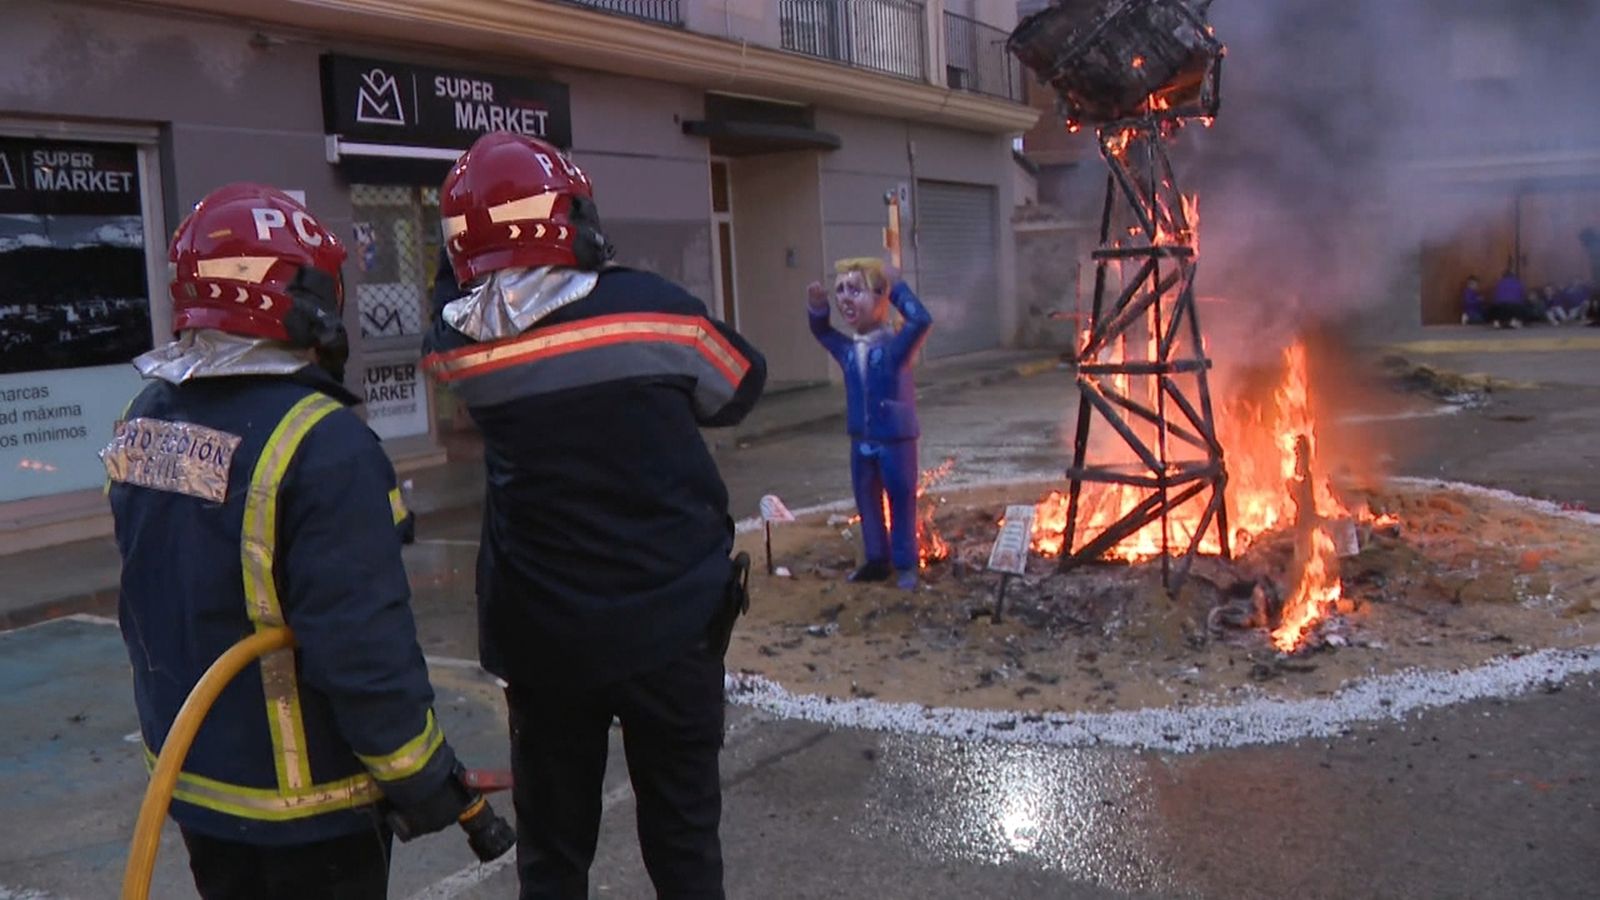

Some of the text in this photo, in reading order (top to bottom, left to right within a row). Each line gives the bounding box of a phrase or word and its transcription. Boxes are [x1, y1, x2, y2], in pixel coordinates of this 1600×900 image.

[434, 76, 494, 101] SUPER
[455, 101, 549, 136] MARKET
[33, 150, 94, 168] SUPER
[34, 169, 132, 192] MARKET
[251, 207, 323, 247] PC
